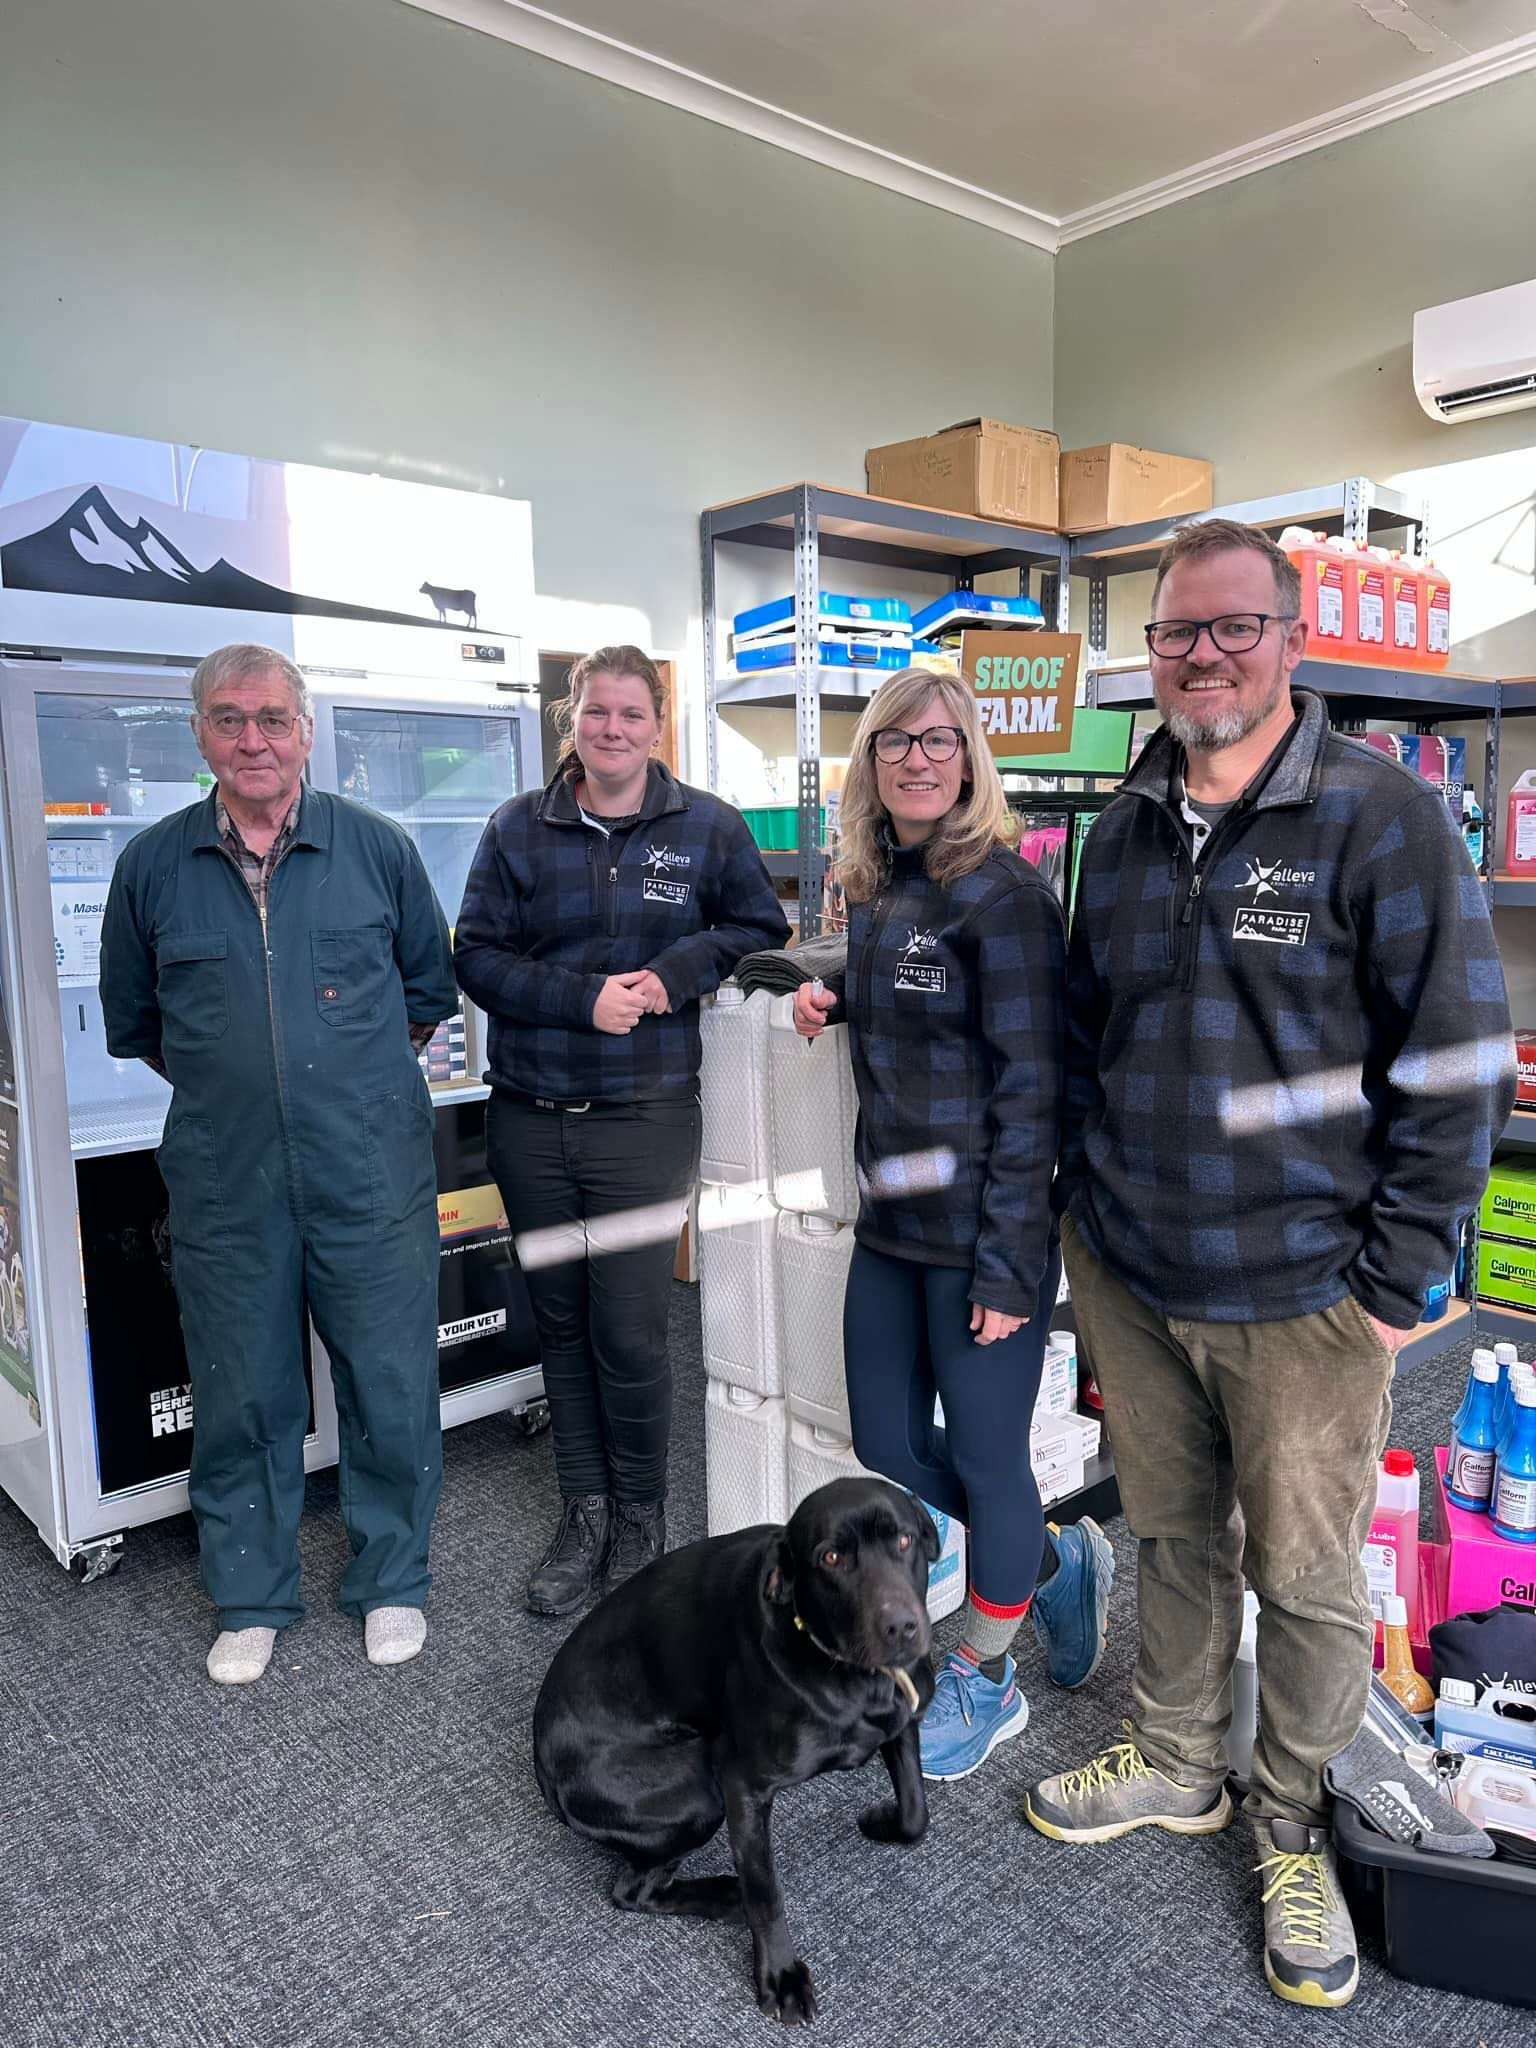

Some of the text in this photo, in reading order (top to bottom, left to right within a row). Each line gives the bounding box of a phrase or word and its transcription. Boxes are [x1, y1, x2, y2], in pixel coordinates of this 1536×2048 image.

[975, 656, 1064, 690] SHOOF
[487, 703, 516, 712] EZICORE
[975, 695, 1062, 736] FARM.
[662, 851, 691, 864] alleva
[1271, 867, 1316, 883] alleva
[647, 881, 687, 894] PARADISE
[1240, 912, 1305, 928] PARADISE
[898, 967, 942, 979] PARADISE
[452, 1246, 465, 1254] and
[465, 1240, 490, 1252] improve
[443, 1320, 476, 1337] YOUR
[477, 1313, 500, 1328] VET
[150, 1386, 180, 1404] GET
[151, 1394, 193, 1415] PERF
[152, 1406, 193, 1438] RE
[1500, 1577, 1536, 1606] Cal
